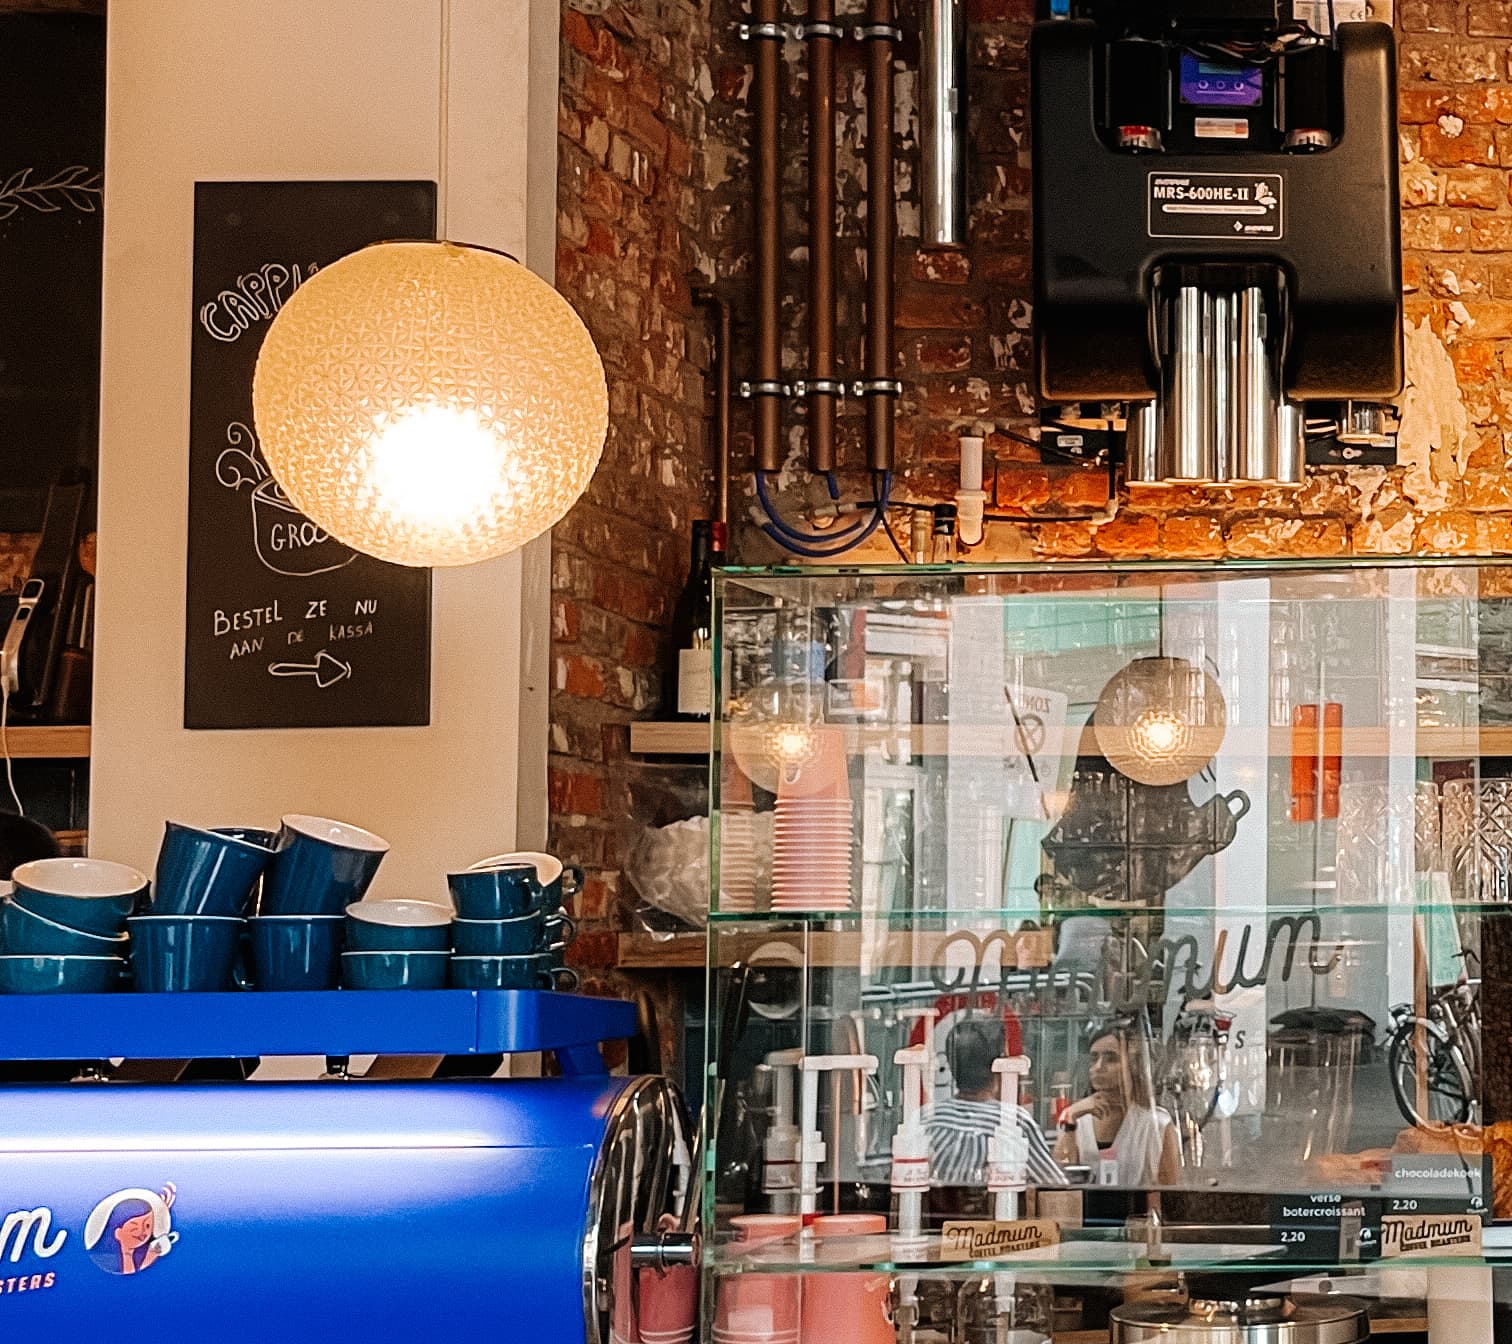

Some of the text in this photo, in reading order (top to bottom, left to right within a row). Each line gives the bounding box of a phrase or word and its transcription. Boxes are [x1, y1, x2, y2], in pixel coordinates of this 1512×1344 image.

[1153, 186, 1249, 201] MRS-600HE-II
[214, 598, 378, 635] BESTEL ZE NU
[229, 637, 265, 659] AAN
[329, 622, 374, 641] KASSA
[1310, 1194, 1341, 1203] verse
[1392, 1200, 1418, 1211] 2.20
[1283, 1207, 1366, 1217] botercroissant
[947, 1223, 1043, 1253] Madmum
[1280, 1231, 1306, 1243] 2.20
[1381, 1219, 1473, 1247] Madmum
